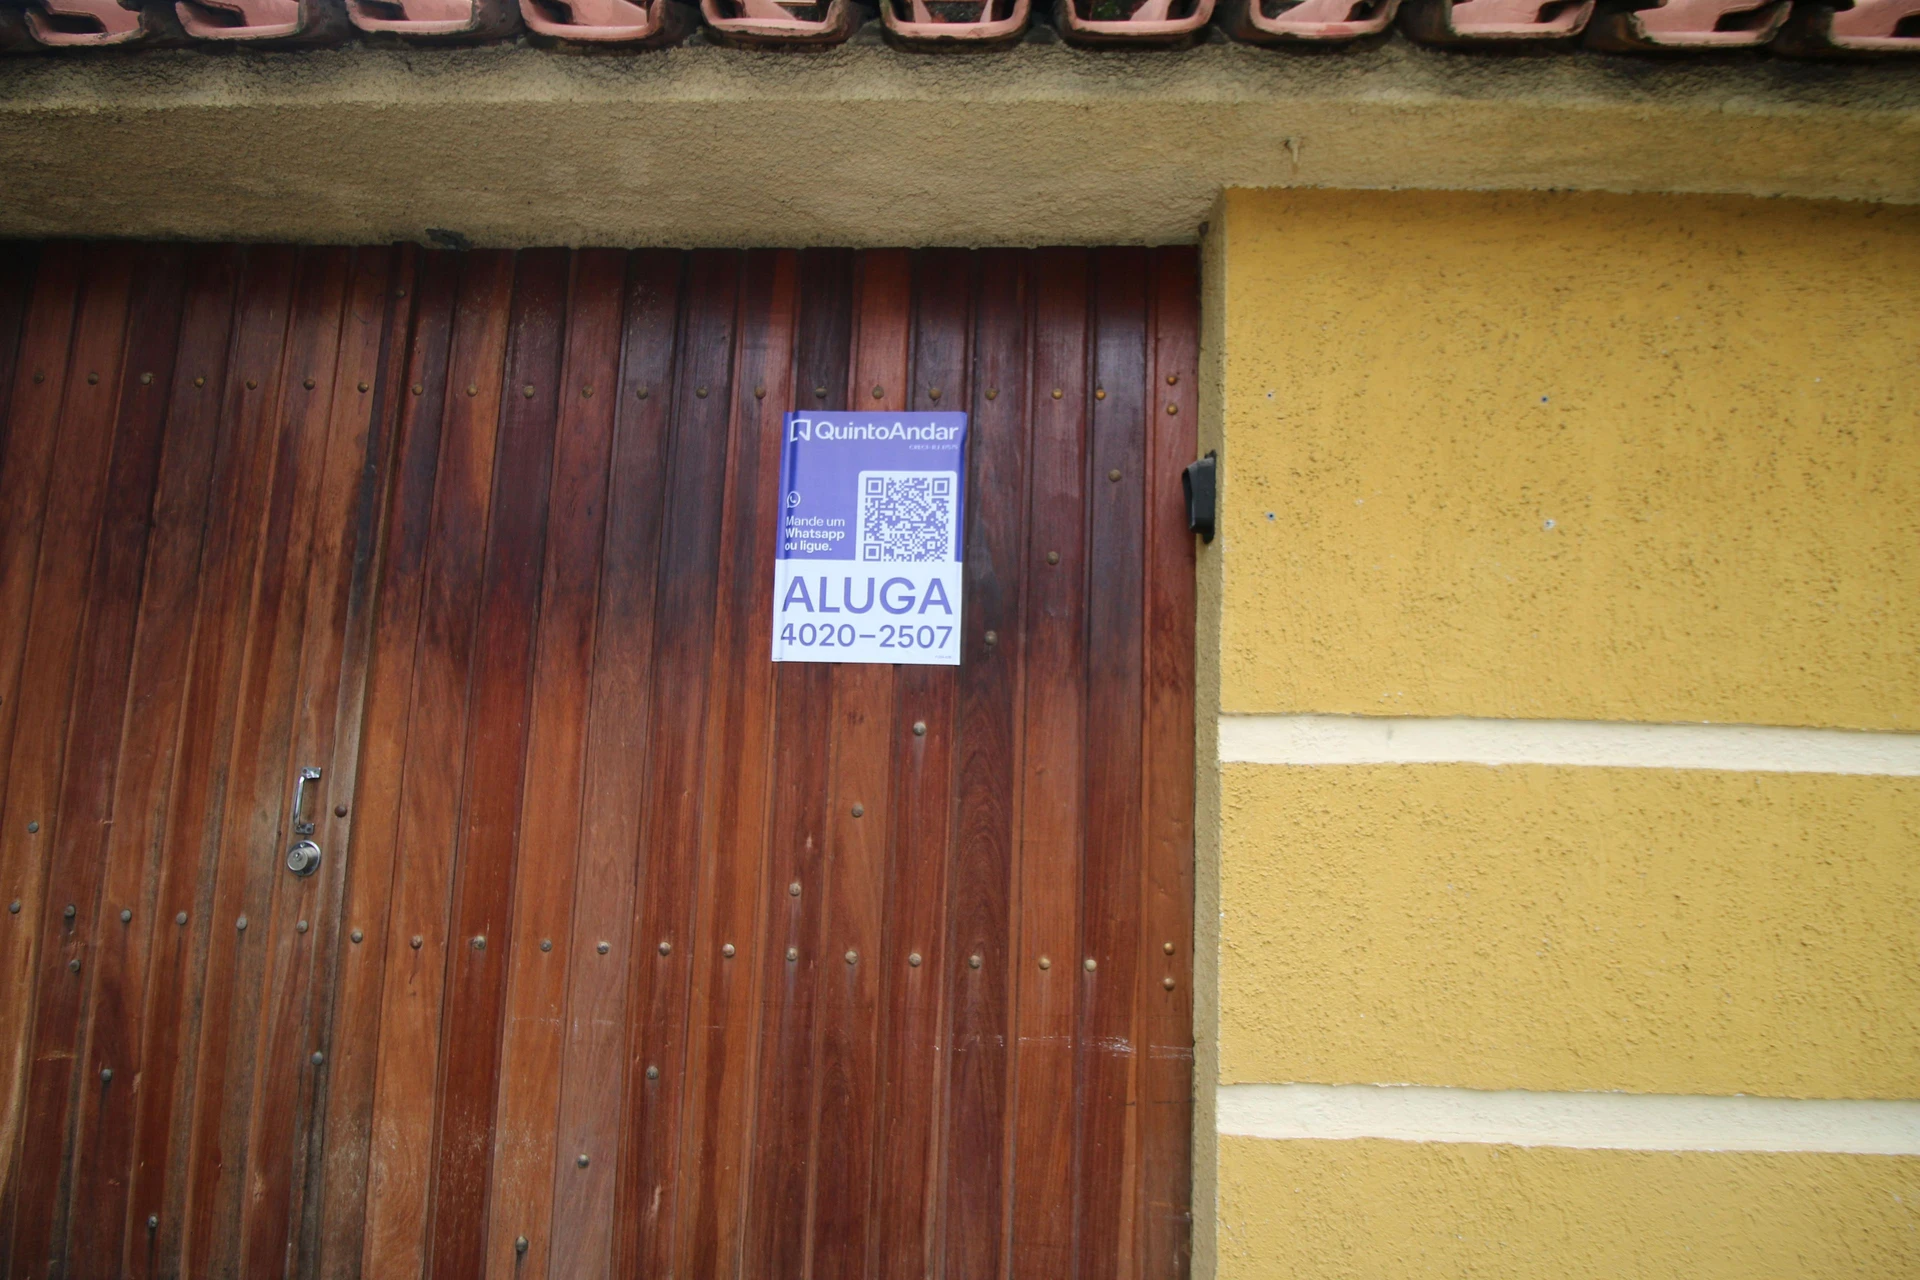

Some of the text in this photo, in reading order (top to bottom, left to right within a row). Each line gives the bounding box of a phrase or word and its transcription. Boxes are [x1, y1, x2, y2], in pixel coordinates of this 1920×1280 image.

[815, 421, 960, 441] QuintoAndar
[785, 516, 846, 527] Mande um
[785, 528, 846, 541] Whatsapp
[784, 541, 833, 554] ou ligue.
[781, 576, 953, 615] ALUGA
[780, 623, 953, 649] 4020-2507
